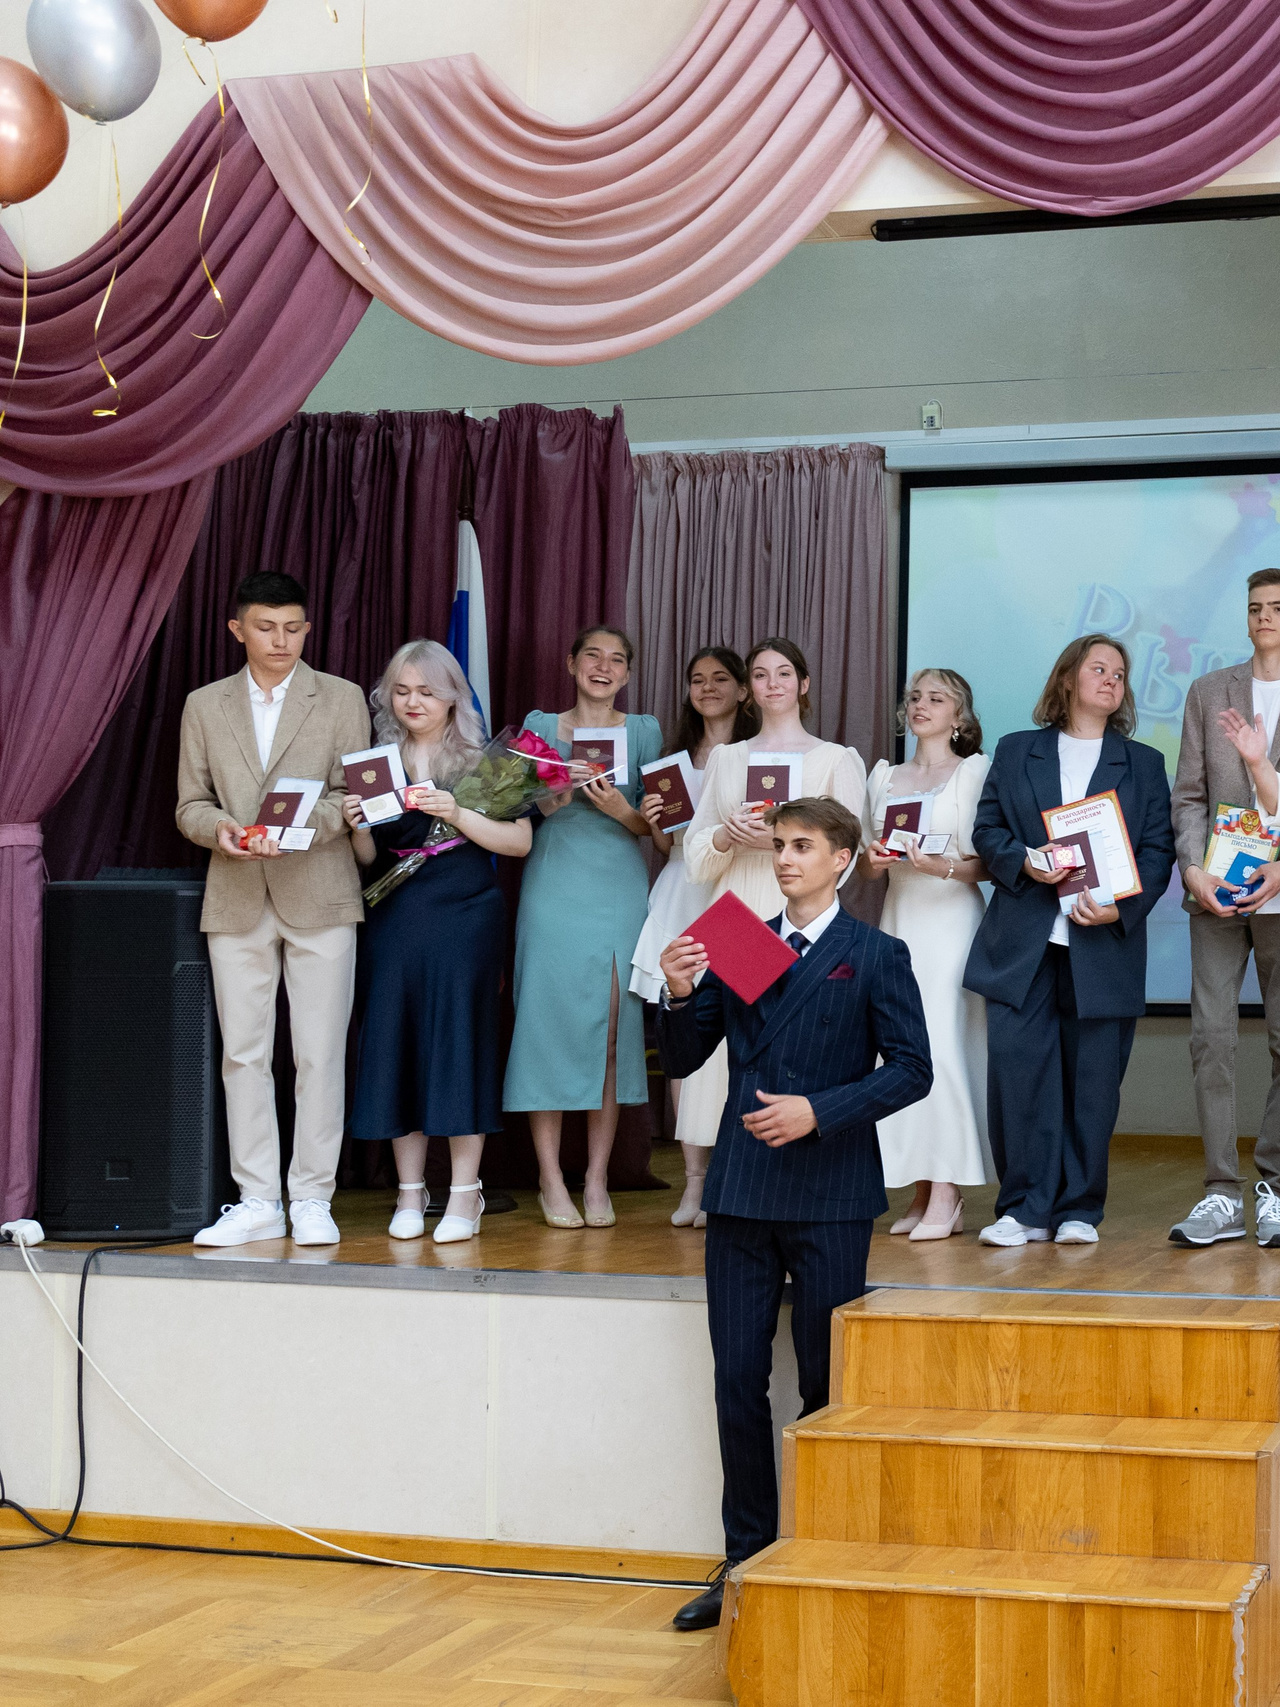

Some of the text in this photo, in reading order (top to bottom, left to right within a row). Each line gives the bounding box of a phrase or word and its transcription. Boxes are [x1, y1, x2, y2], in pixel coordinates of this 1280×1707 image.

[1056, 802, 1107, 821] Благодарность
[1064, 811, 1102, 827] родителям
[1230, 840, 1258, 850] ПИСЬМО
